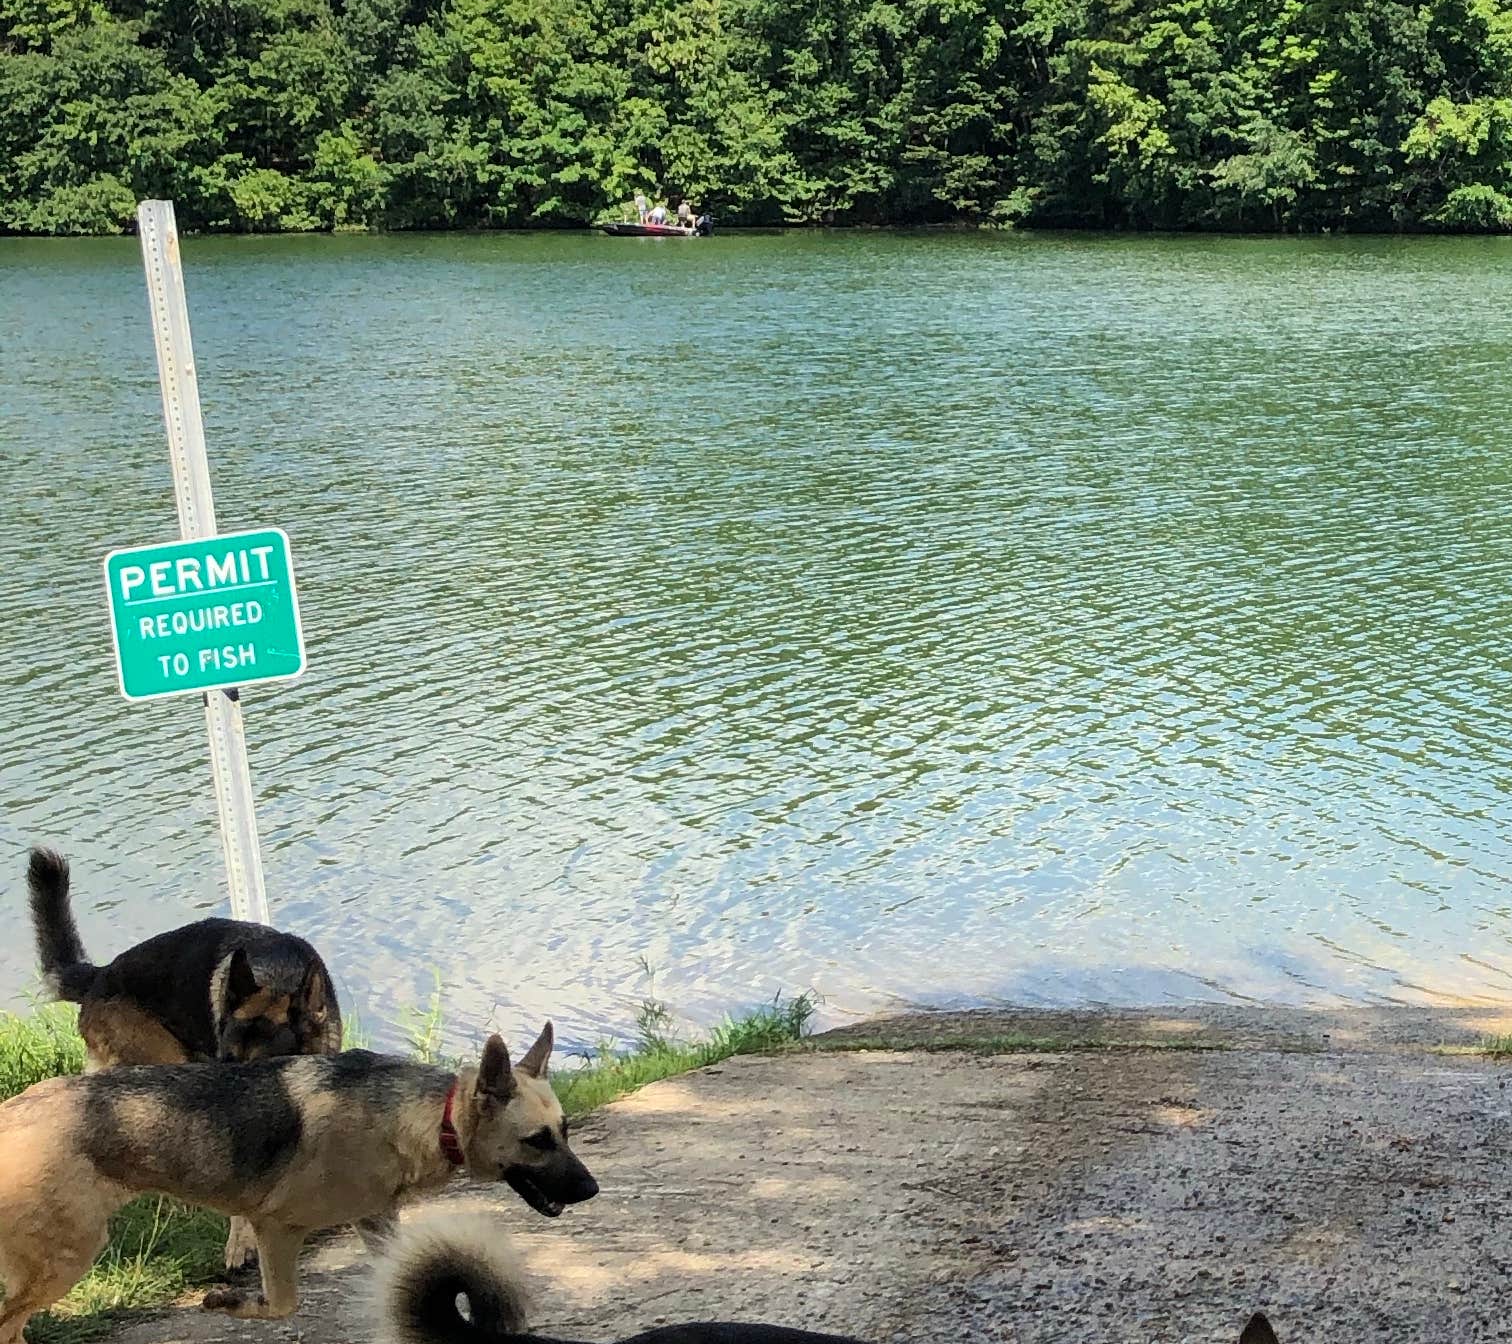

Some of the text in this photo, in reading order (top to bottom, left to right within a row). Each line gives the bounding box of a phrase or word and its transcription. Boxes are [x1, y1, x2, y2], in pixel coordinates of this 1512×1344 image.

[119, 545, 274, 601] PERMIT
[139, 601, 263, 640] REQUIRED
[157, 643, 256, 678] TO FISH
